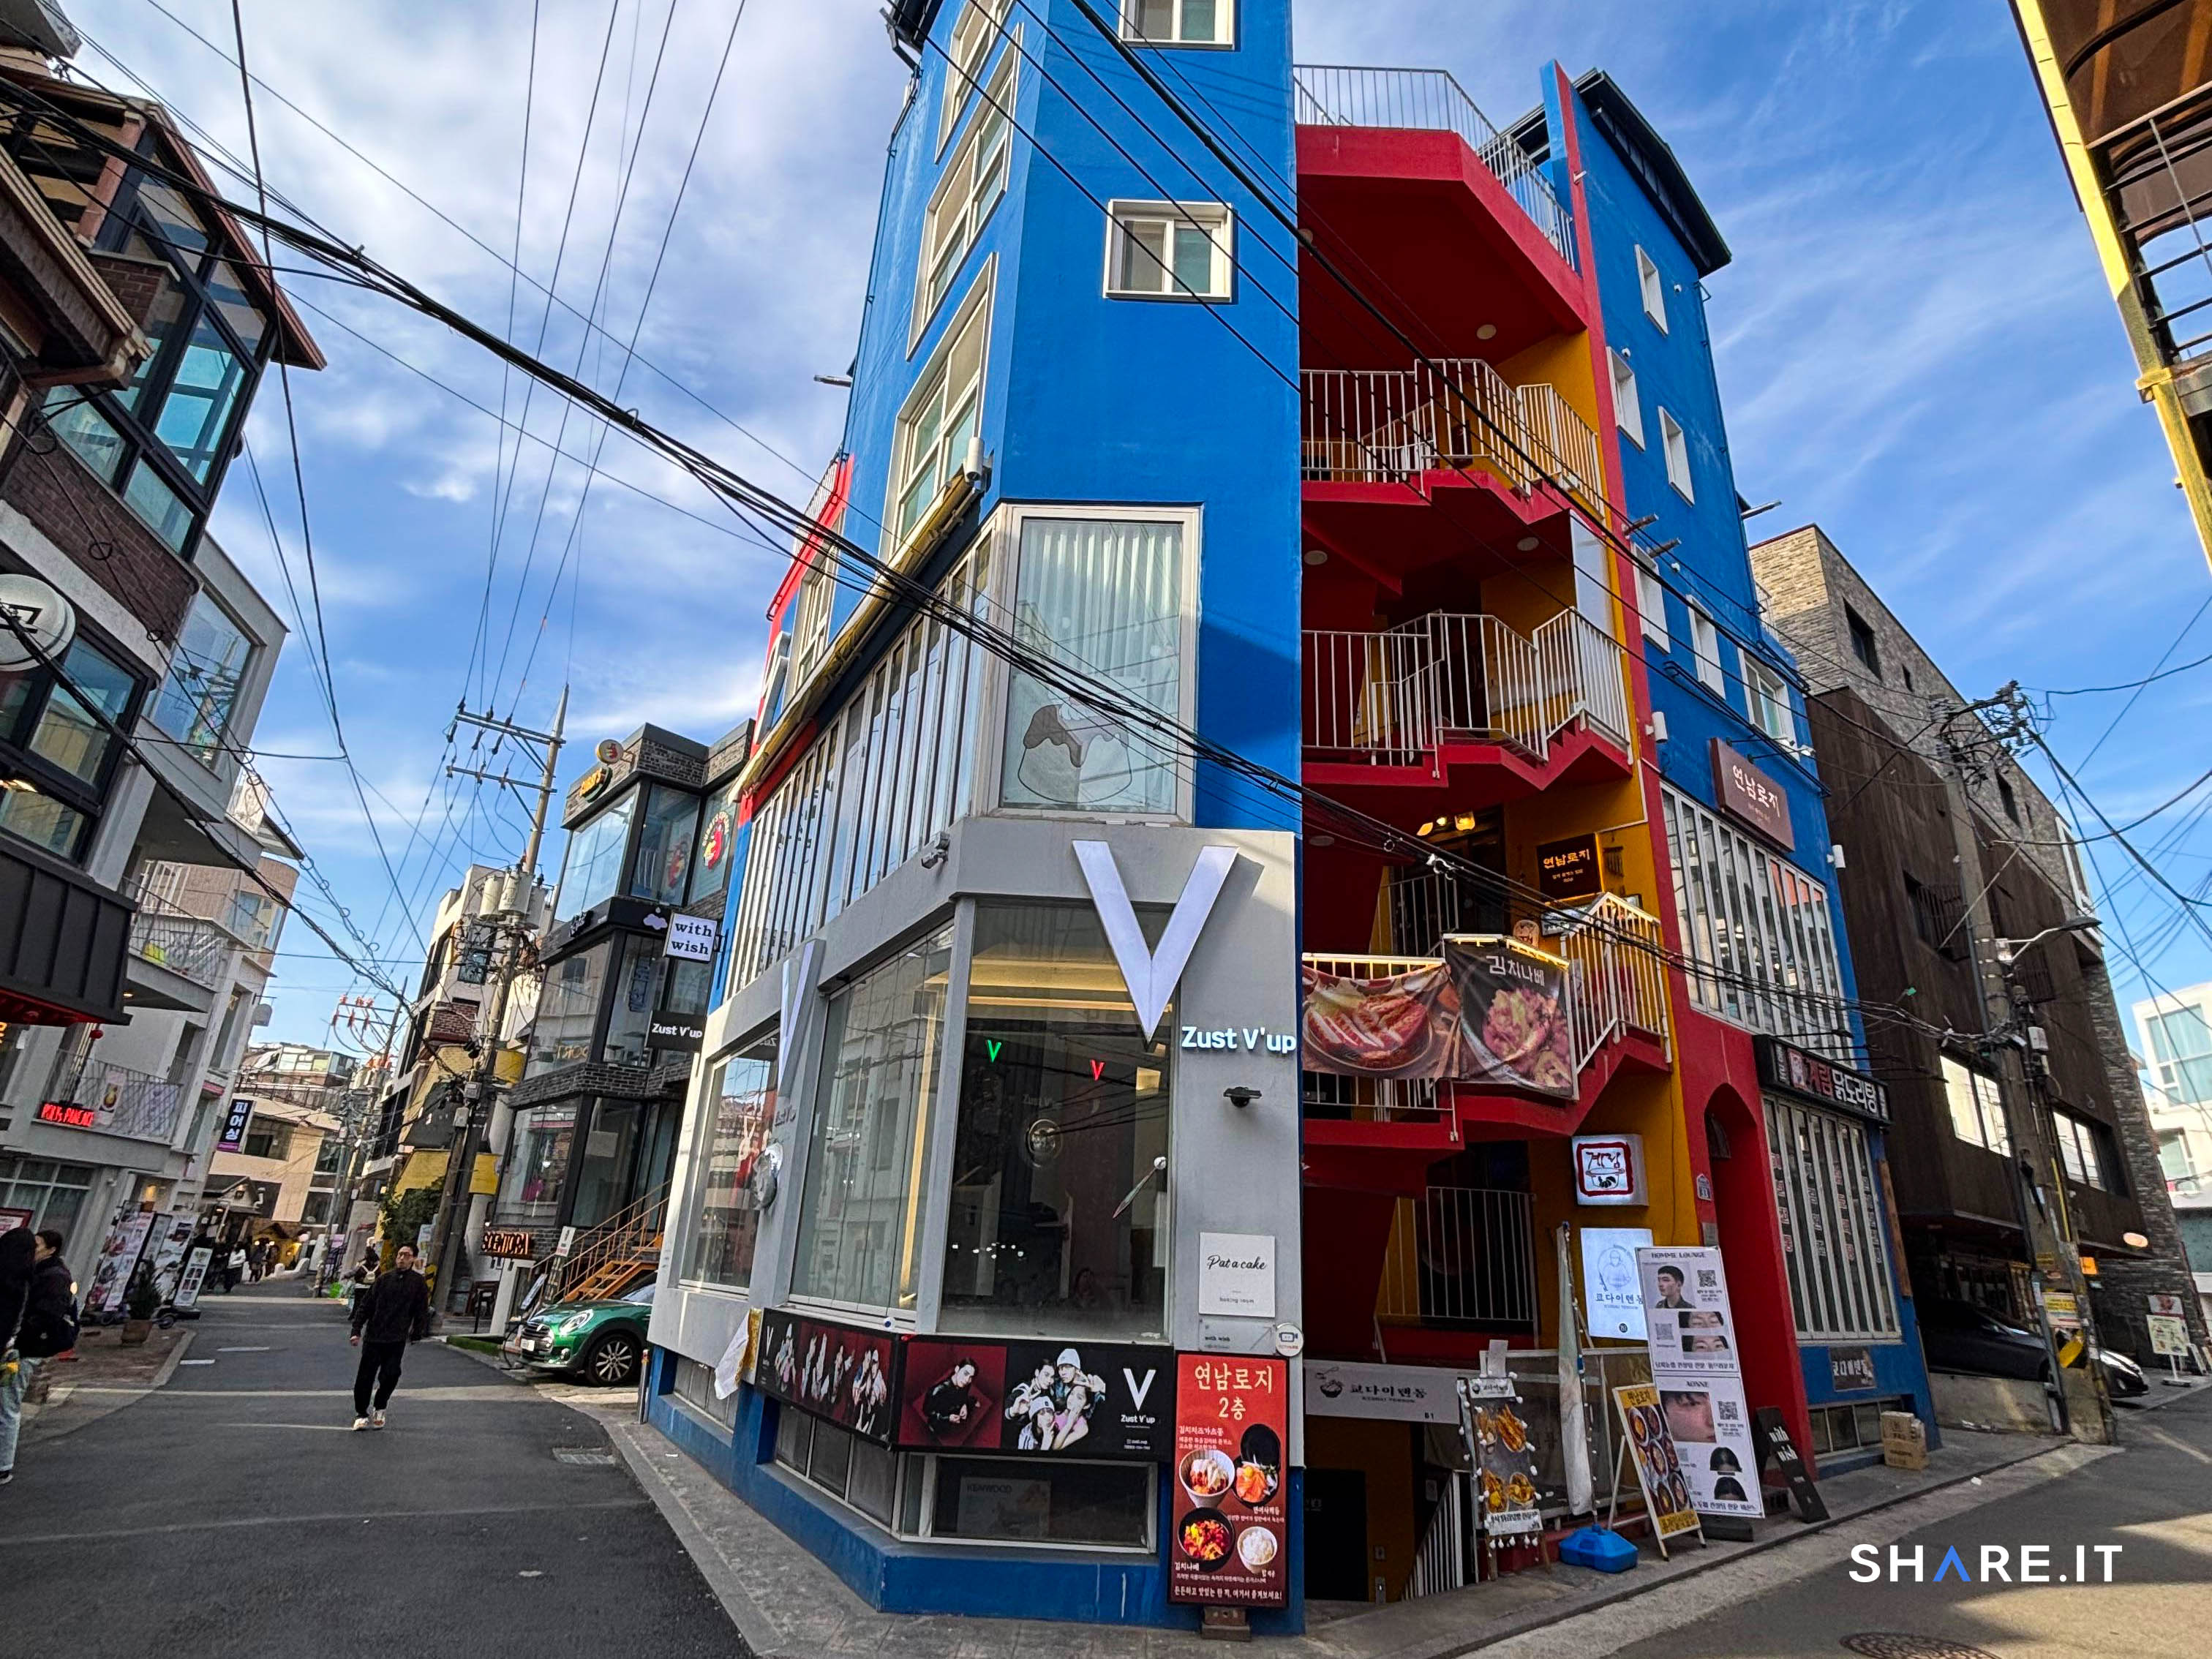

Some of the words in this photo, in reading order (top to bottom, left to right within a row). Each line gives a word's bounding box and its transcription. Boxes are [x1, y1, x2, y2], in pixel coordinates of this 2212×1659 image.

[1732, 764, 1780, 818] 연남로지
[1543, 849, 1590, 869] 연남로지
[675, 922, 712, 938] with
[1072, 840, 1239, 1043] V
[672, 940, 709, 955] wish
[1486, 955, 1545, 986] 김치나베
[652, 1023, 678, 1035] Zust
[679, 1026, 703, 1039] V'up
[1181, 1026, 1238, 1050] Zust
[1243, 1026, 1298, 1054] V'up
[1832, 1068, 1878, 1113] 닭도리탕
[225, 1102, 249, 1140] 피어싱
[1207, 1254, 1230, 1270] Pat
[1232, 1260, 1239, 1268] a
[1241, 1256, 1266, 1270] cake
[1123, 1368, 1156, 1412] V
[1195, 1362, 1273, 1394] 연남로지
[1121, 1414, 1138, 1423] Zust
[1139, 1414, 1156, 1424] V'up
[1219, 1396, 1246, 1421] 2층
